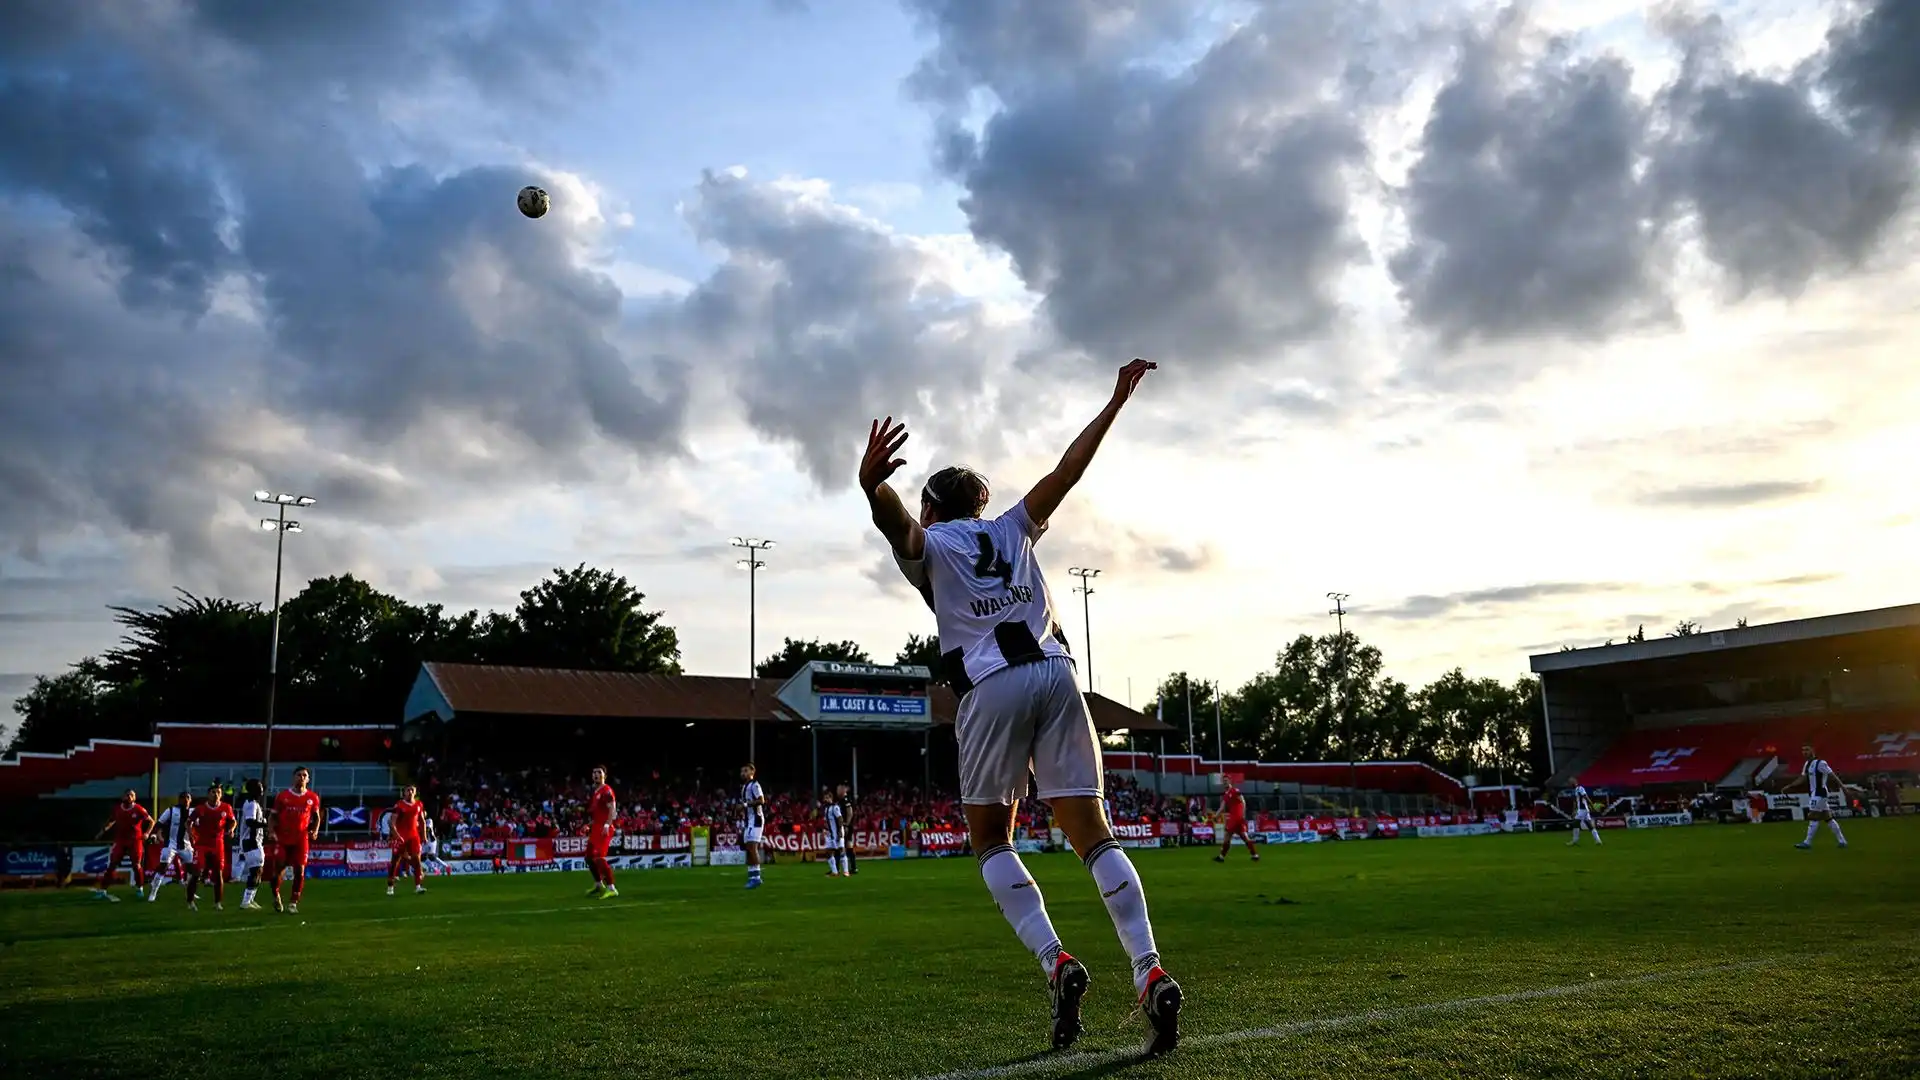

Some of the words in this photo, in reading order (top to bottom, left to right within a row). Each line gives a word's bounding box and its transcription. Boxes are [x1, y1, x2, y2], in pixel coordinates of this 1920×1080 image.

[974, 532, 1013, 590] 4
[970, 585, 1034, 617] WALLNER
[831, 663, 868, 674] Dulux
[822, 697, 841, 711] J.M.
[842, 697, 866, 711] CASEY
[868, 698, 876, 711] &
[851, 830, 900, 850] EARG
[921, 832, 954, 845] BOYS
